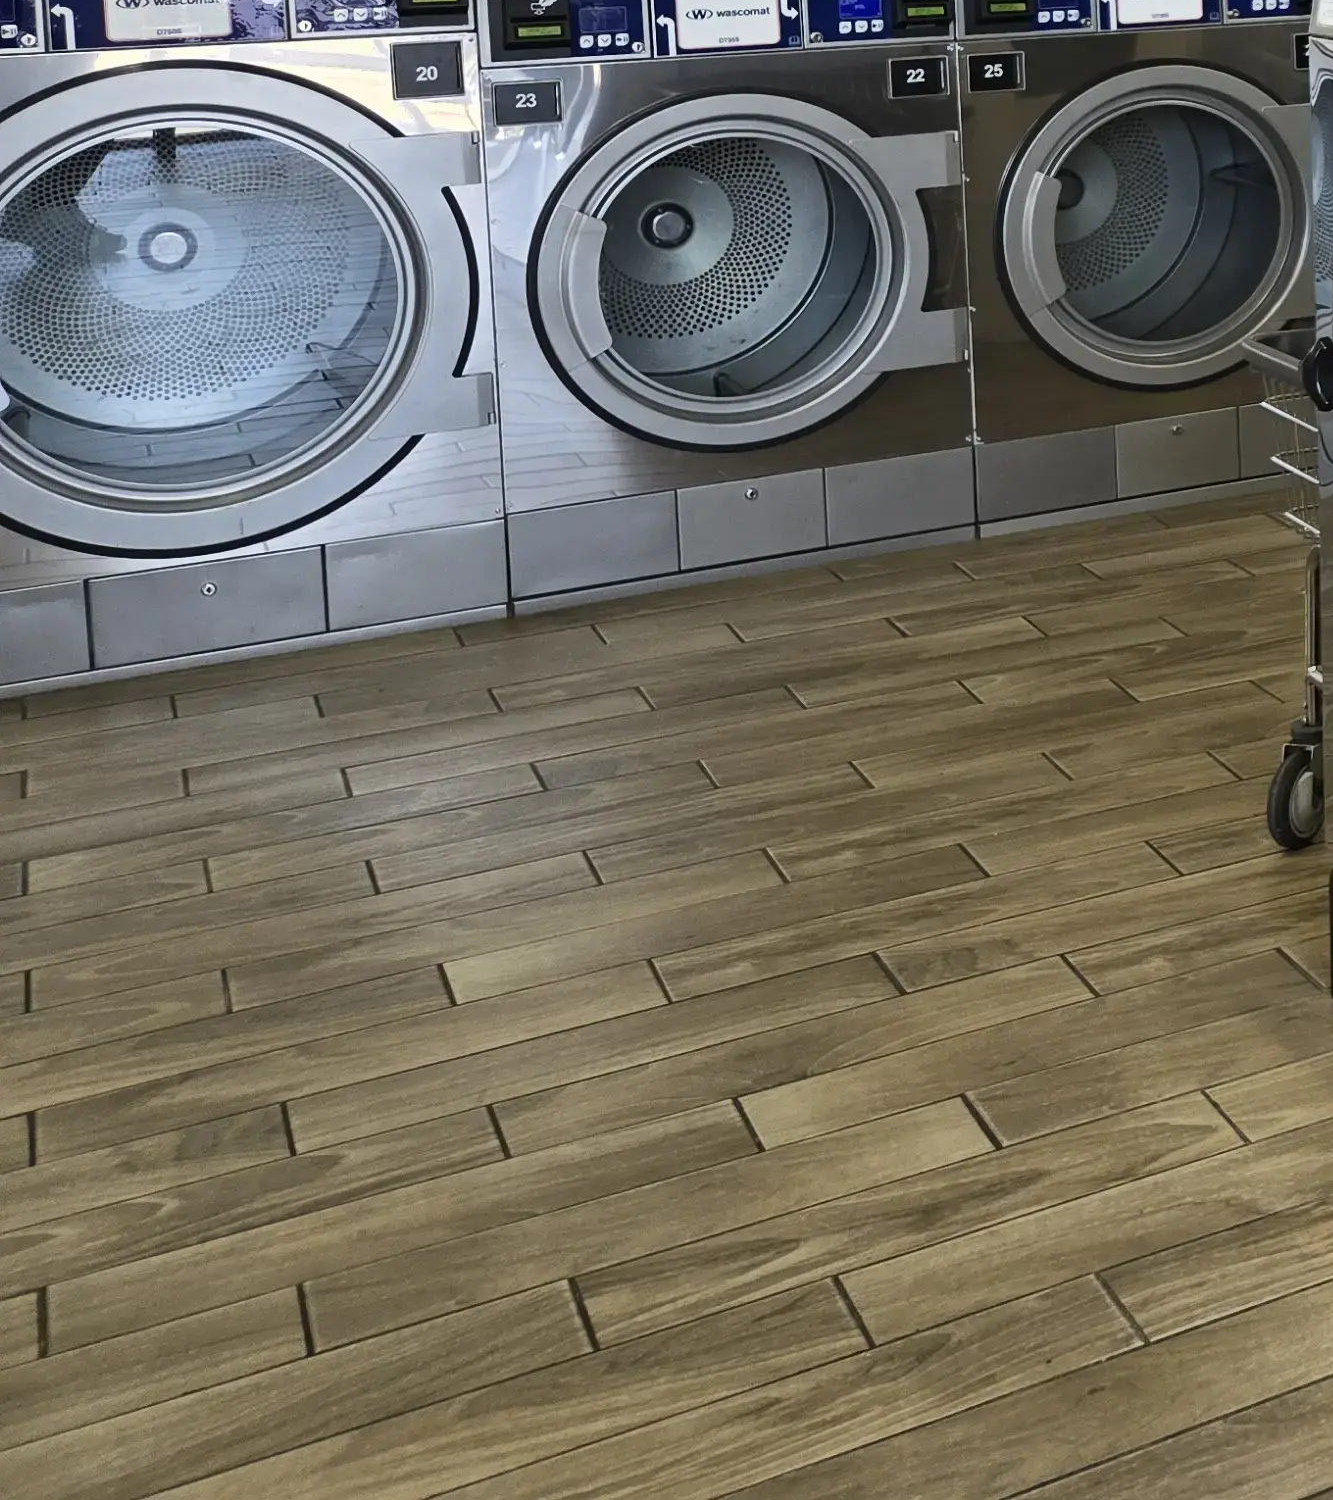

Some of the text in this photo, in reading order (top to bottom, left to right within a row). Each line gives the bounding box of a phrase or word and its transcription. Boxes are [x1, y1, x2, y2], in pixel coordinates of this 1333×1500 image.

[717, 7, 770, 17] wascomat
[415, 65, 438, 82] 20
[906, 68, 926, 84] 22
[984, 63, 1004, 79] 25
[515, 92, 537, 109] 23
